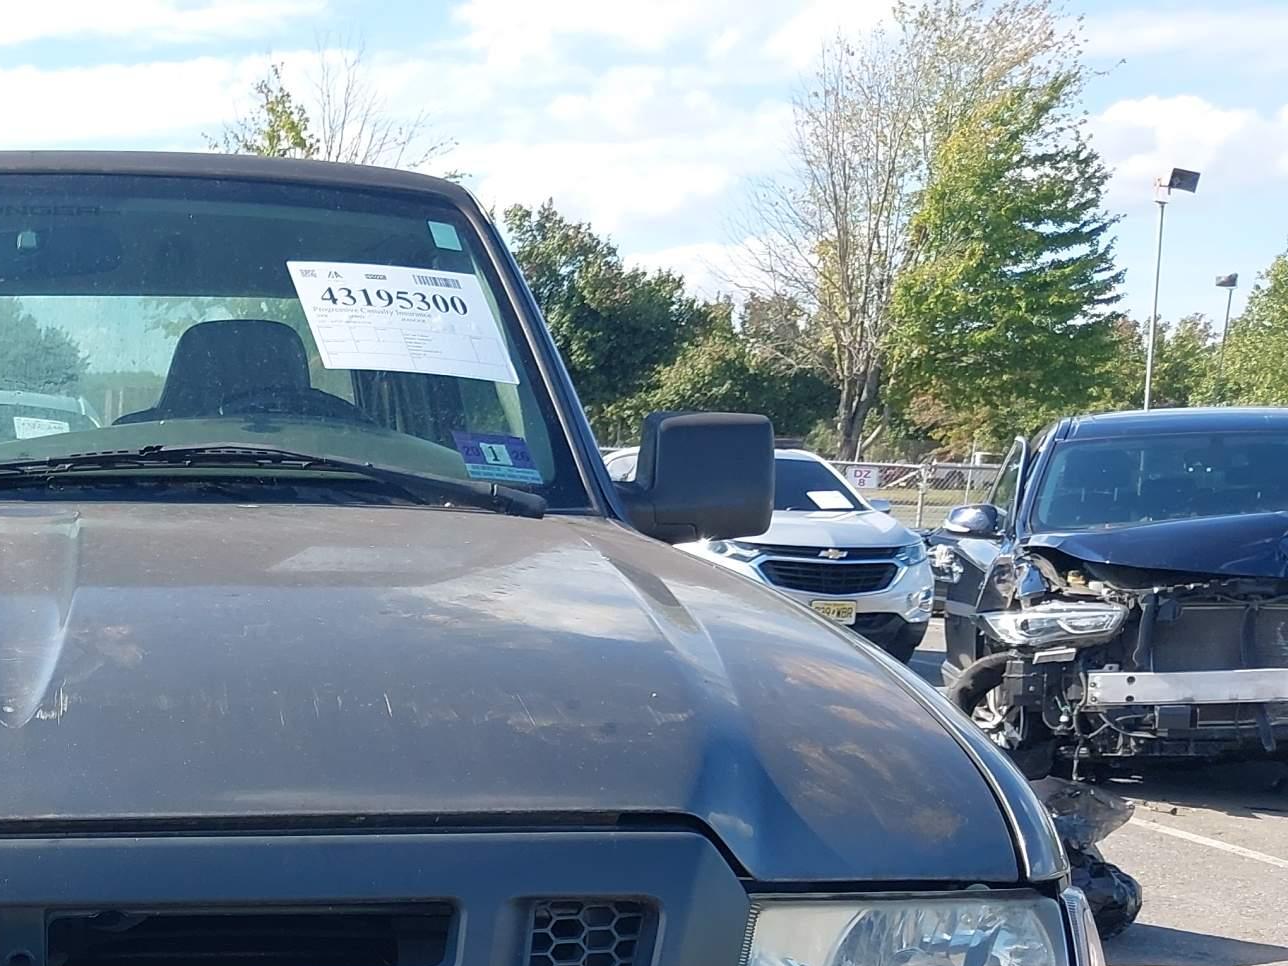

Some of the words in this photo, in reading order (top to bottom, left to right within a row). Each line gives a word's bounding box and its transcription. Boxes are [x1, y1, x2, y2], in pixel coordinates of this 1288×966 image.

[320, 286, 468, 316] 43195300
[488, 445, 501, 462] 1
[854, 470, 872, 478] DZ
